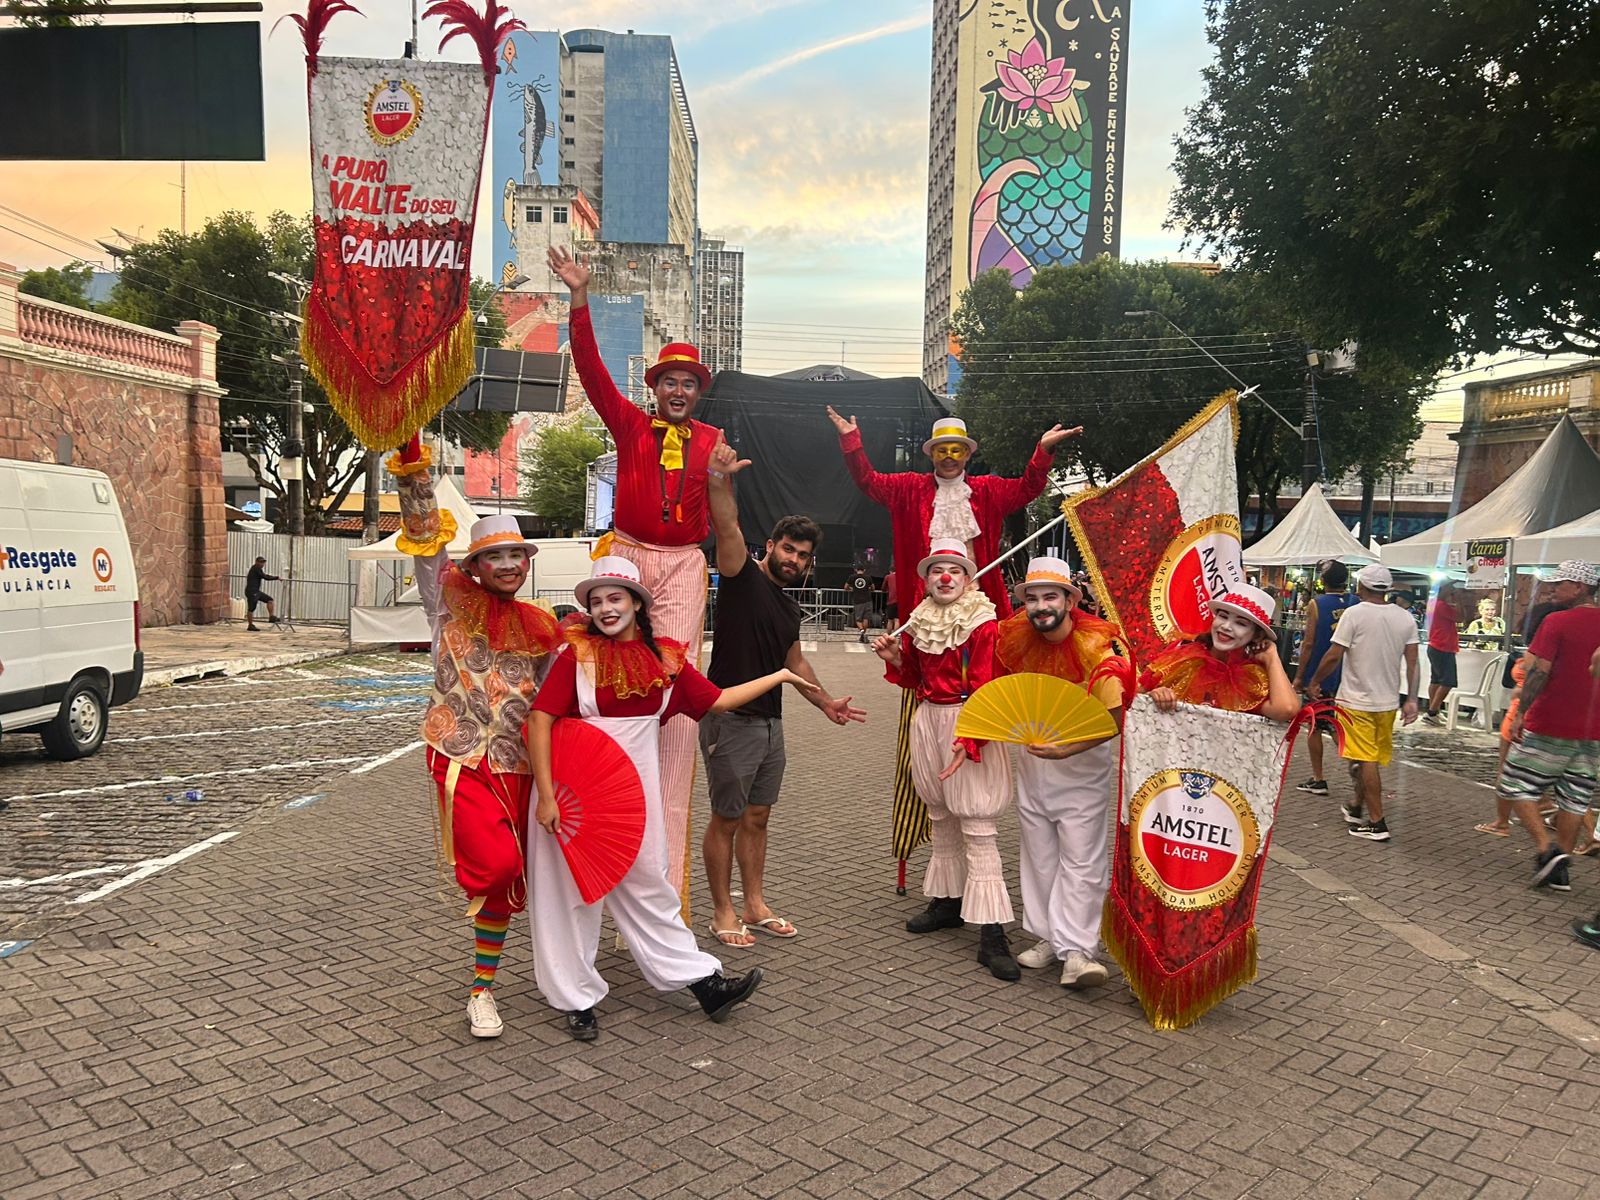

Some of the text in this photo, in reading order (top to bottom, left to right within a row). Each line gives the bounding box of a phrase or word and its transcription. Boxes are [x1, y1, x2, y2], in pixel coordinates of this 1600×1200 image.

[1110, 6, 1121, 18] A
[1108, 27, 1121, 102] SAUDADE
[375, 101, 409, 112] AMSTEL
[322, 155, 387, 183] A PURO
[1104, 109, 1117, 212] ENCHARCADA
[329, 181, 457, 215] MALTE DO SEU
[1103, 216, 1114, 244] NOS
[341, 235, 466, 270] CARNAVAL
[5, 546, 77, 574] Resgate
[1470, 541, 1503, 556] Carne
[1202, 546, 1229, 600] AMST
[1225, 560, 1240, 583] 1870
[1153, 556, 1171, 631] AMSTERDA
[1193, 575, 1210, 621] LAGER
[1131, 776, 1247, 822] PREMIUM BIER
[1182, 804, 1204, 814] 1870
[1151, 812, 1232, 847] AMSTEL
[1163, 843, 1209, 863] LAGER
[1133, 853, 1255, 906] AMSTERDAM HOLLAND
